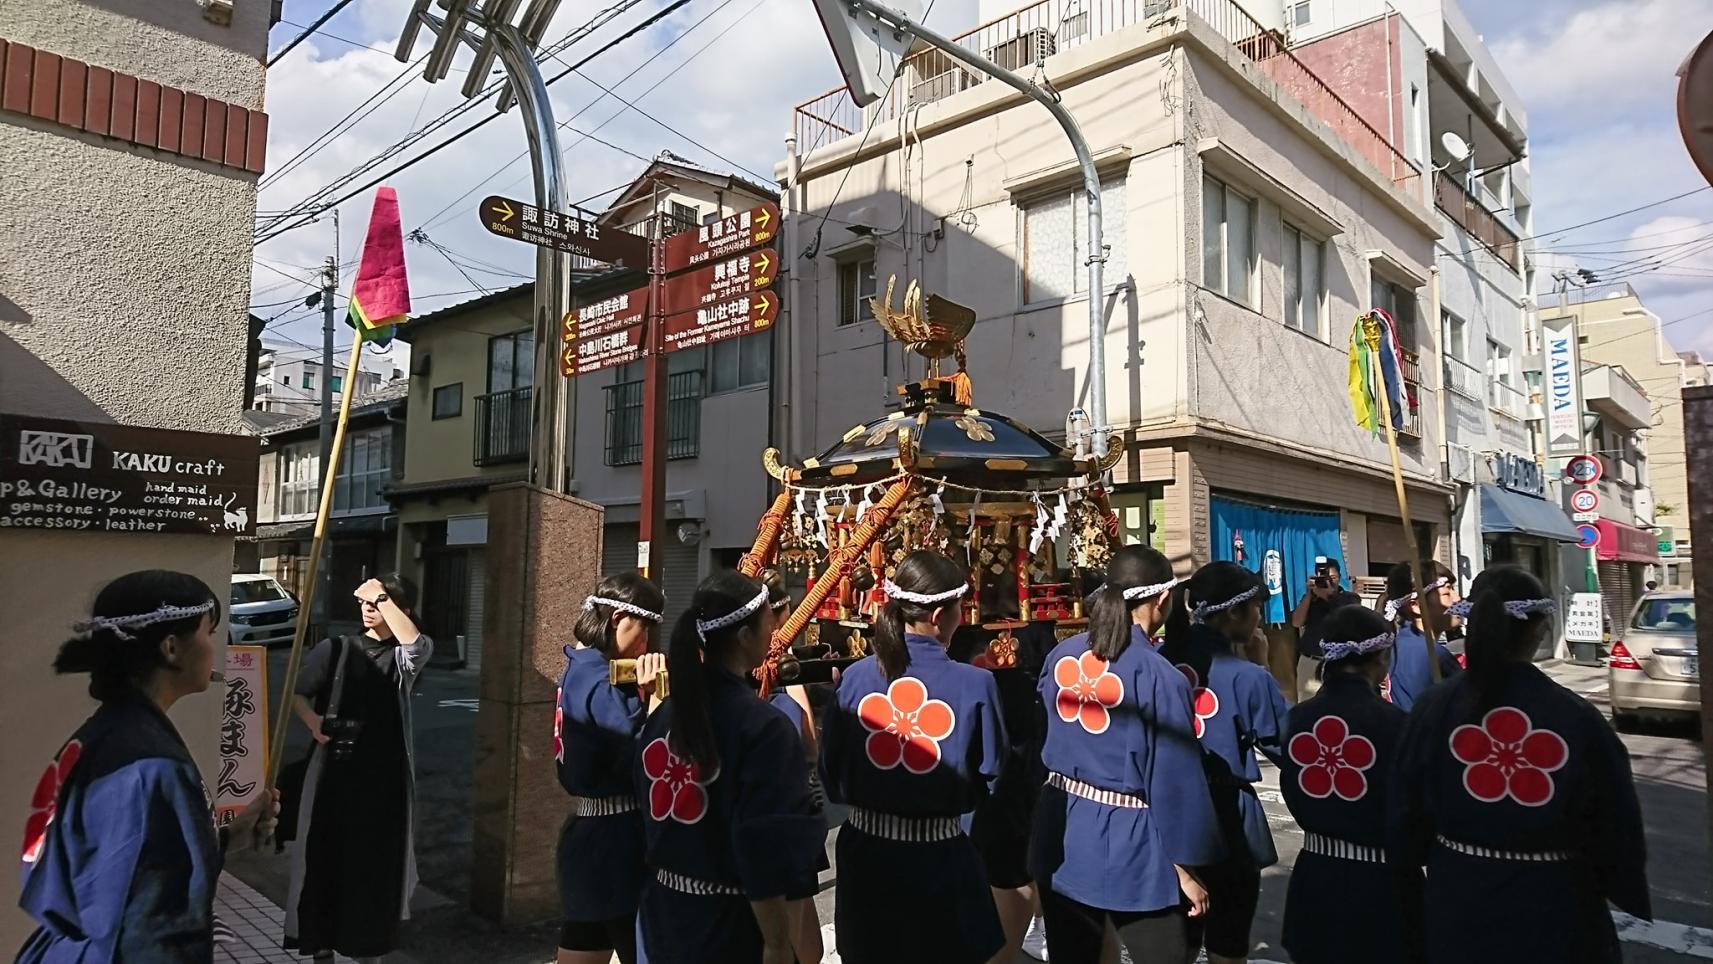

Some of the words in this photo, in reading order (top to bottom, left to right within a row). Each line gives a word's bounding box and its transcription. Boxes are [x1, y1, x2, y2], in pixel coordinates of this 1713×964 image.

[492, 222, 514, 235] 800m
[522, 205, 600, 240] 諏訪神社
[699, 211, 751, 243] 風頭公園
[522, 222, 543, 234] Suwa
[544, 228, 568, 240] Shrine
[738, 229, 751, 238] Park
[755, 232, 770, 241] 800m
[559, 242, 591, 256] 스와신사
[715, 256, 750, 281] 興福寺
[731, 274, 750, 284] Temple
[754, 277, 769, 286] 200m
[687, 328, 704, 337] Former
[1551, 338, 1571, 411] MAEDA
[19, 430, 94, 469] KAKU
[113, 451, 172, 472] KAKU
[175, 459, 225, 476] craft
[145, 481, 175, 493] hand
[177, 485, 207, 495] maid
[143, 494, 182, 505] order
[187, 494, 223, 507] maid
[1578, 496, 1594, 507] 20
[10, 502, 94, 515] gemstone
[0, 516, 91, 530] accessory
[105, 519, 167, 531] leather
